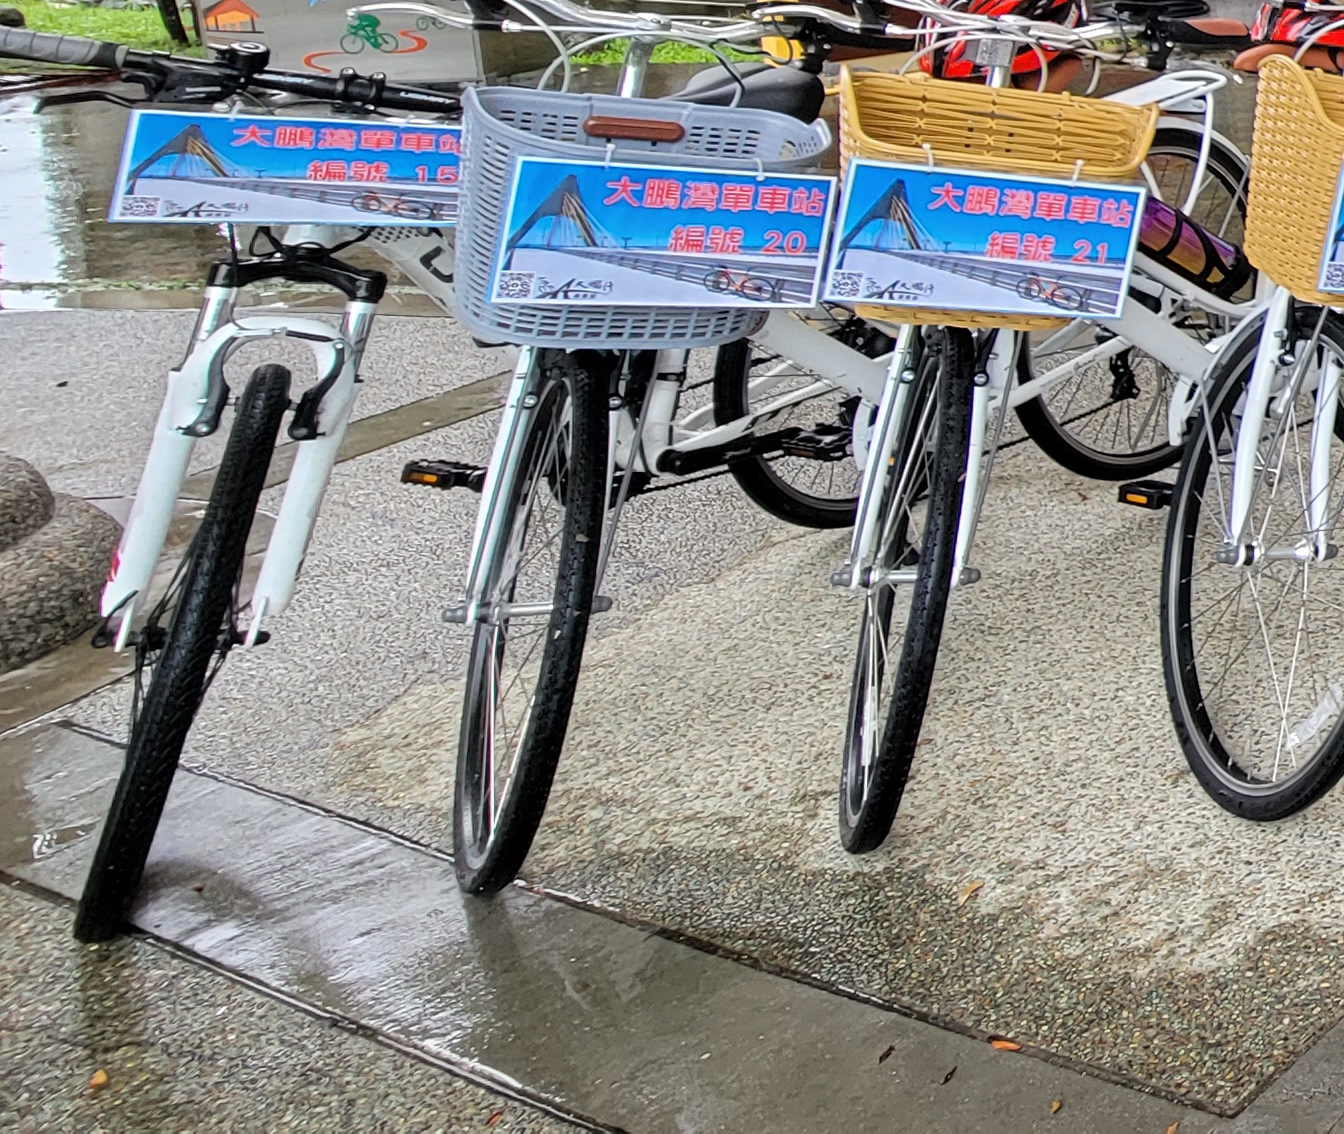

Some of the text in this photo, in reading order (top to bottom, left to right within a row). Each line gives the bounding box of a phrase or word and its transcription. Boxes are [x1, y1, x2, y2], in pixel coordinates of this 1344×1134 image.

[307, 160, 458, 183] 編號 15
[602, 176, 826, 217] 大鵬灣單車站
[927, 182, 1134, 228] 大鵬灣單車站
[669, 224, 807, 254] 編號 20
[984, 231, 1108, 265] 編號 21
